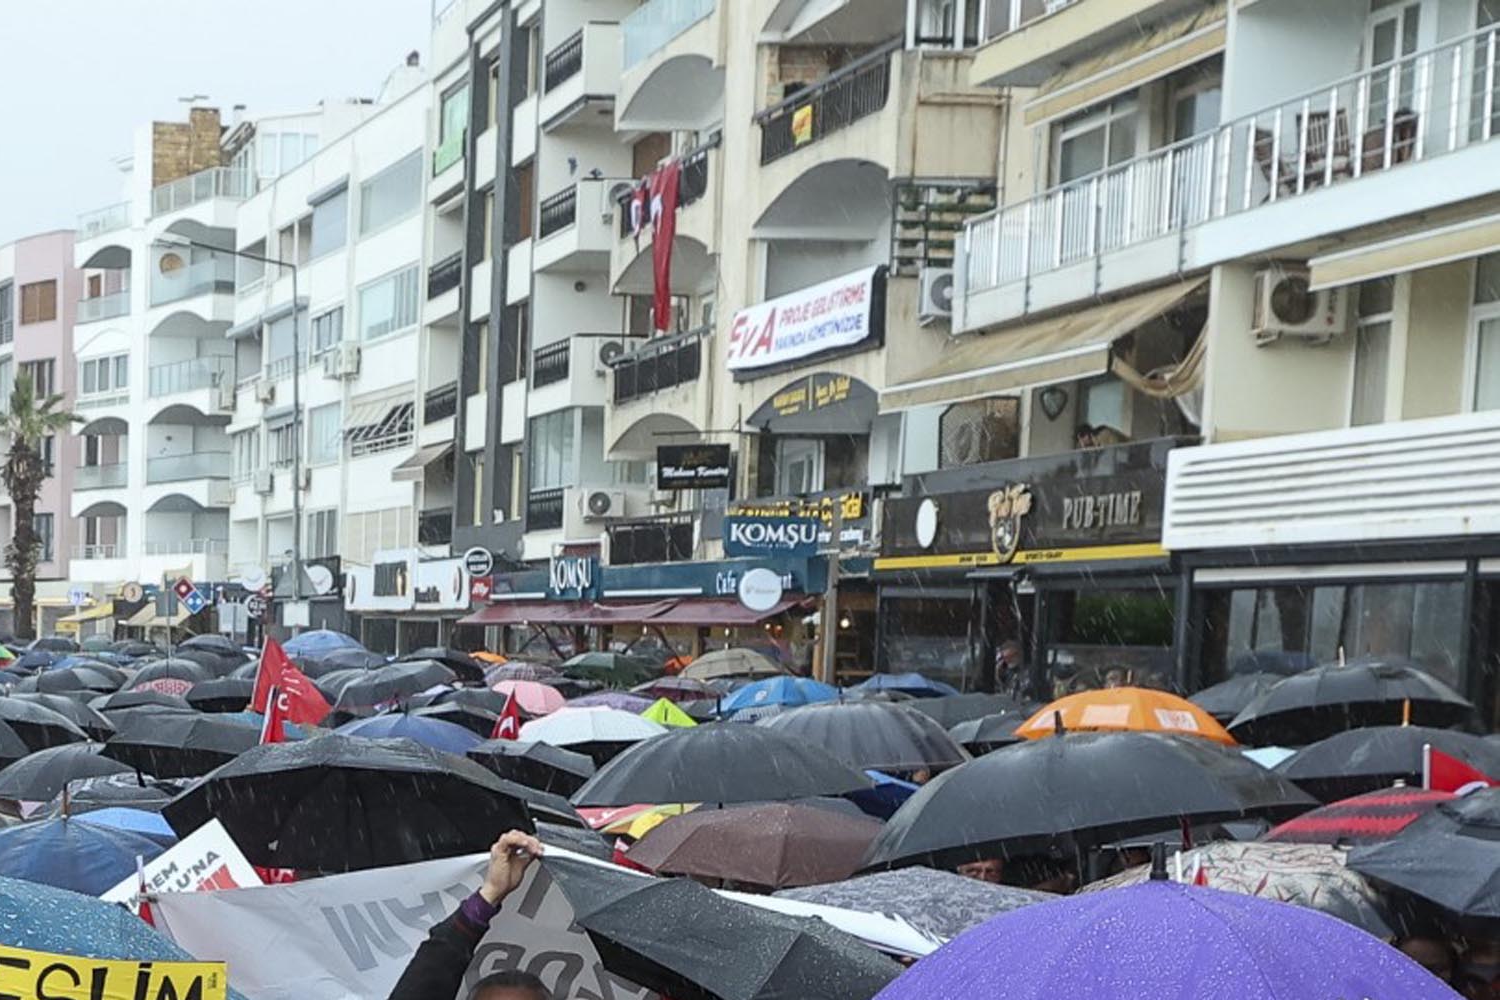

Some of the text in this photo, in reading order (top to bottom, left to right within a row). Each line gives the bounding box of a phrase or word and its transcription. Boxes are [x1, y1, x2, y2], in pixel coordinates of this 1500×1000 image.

[730, 522, 817, 549] KOMŞU
[550, 557, 592, 598] KOMŞU
[715, 570, 737, 595] Cafe
